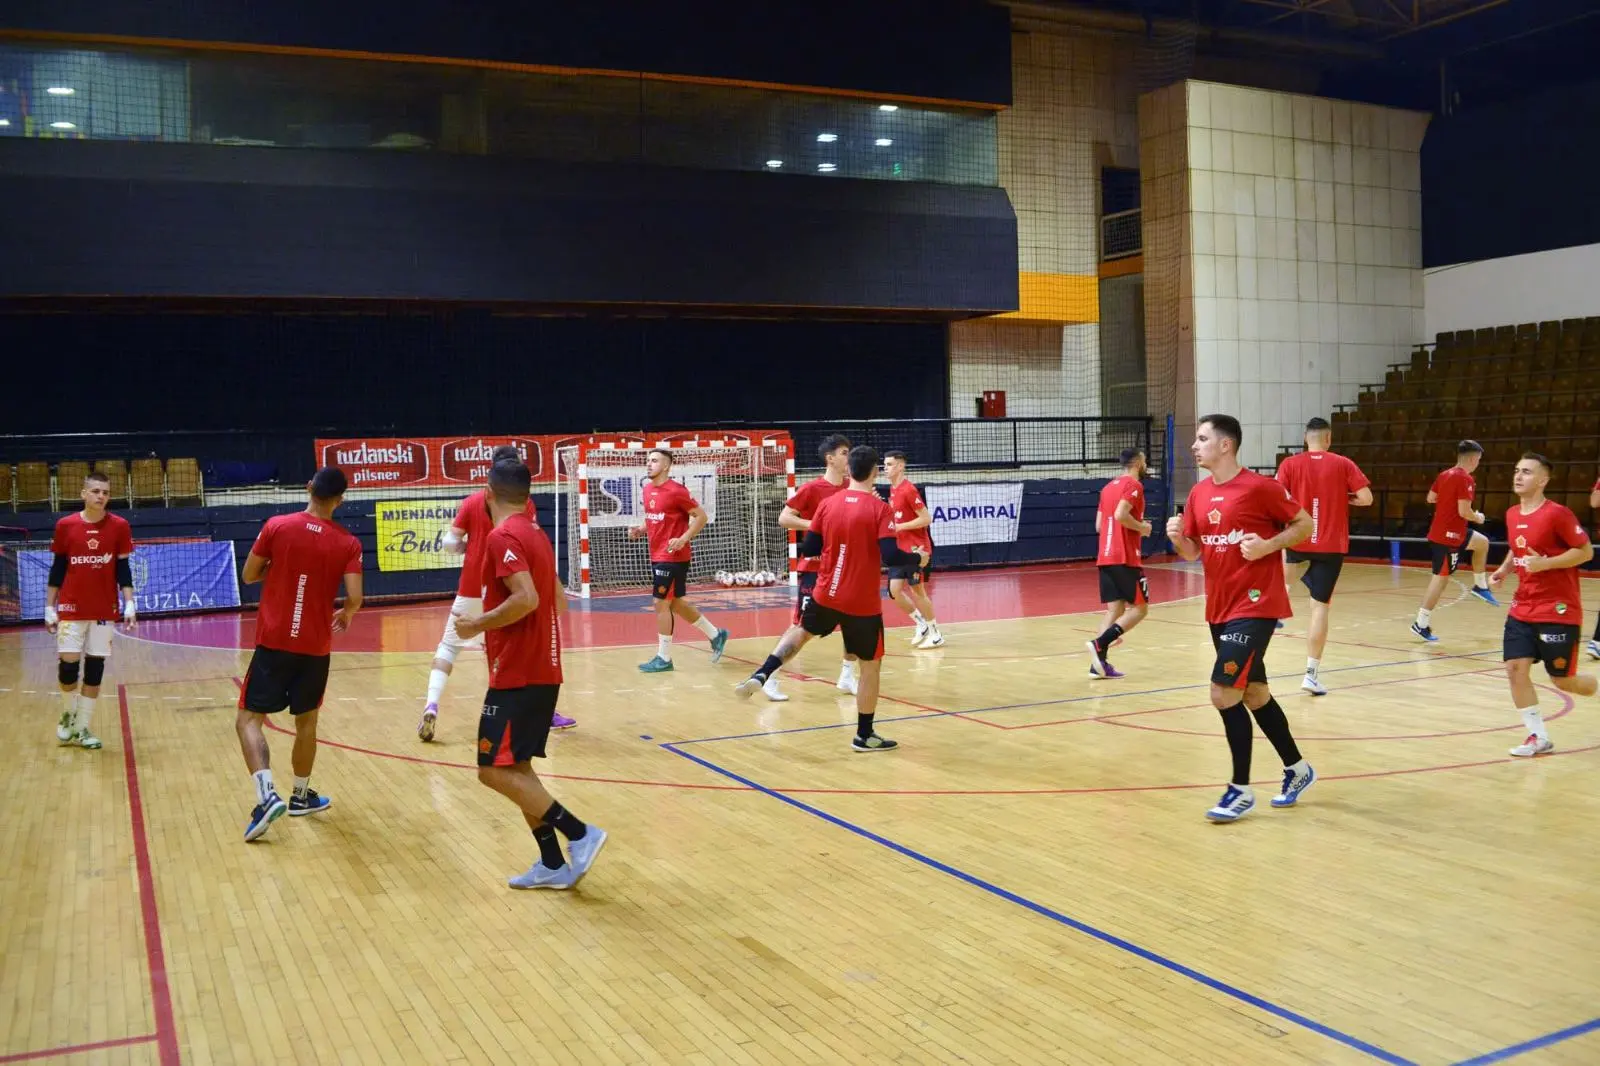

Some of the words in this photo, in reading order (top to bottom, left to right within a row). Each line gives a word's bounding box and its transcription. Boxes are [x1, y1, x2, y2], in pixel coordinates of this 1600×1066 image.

[336, 442, 413, 464] tuzlanski
[454, 439, 528, 461] tuzlai
[353, 468, 400, 484] pilsner
[382, 505, 458, 520] MJENJAČNI
[932, 503, 1017, 523] ADMIRAL
[132, 592, 203, 611] TUZLA
